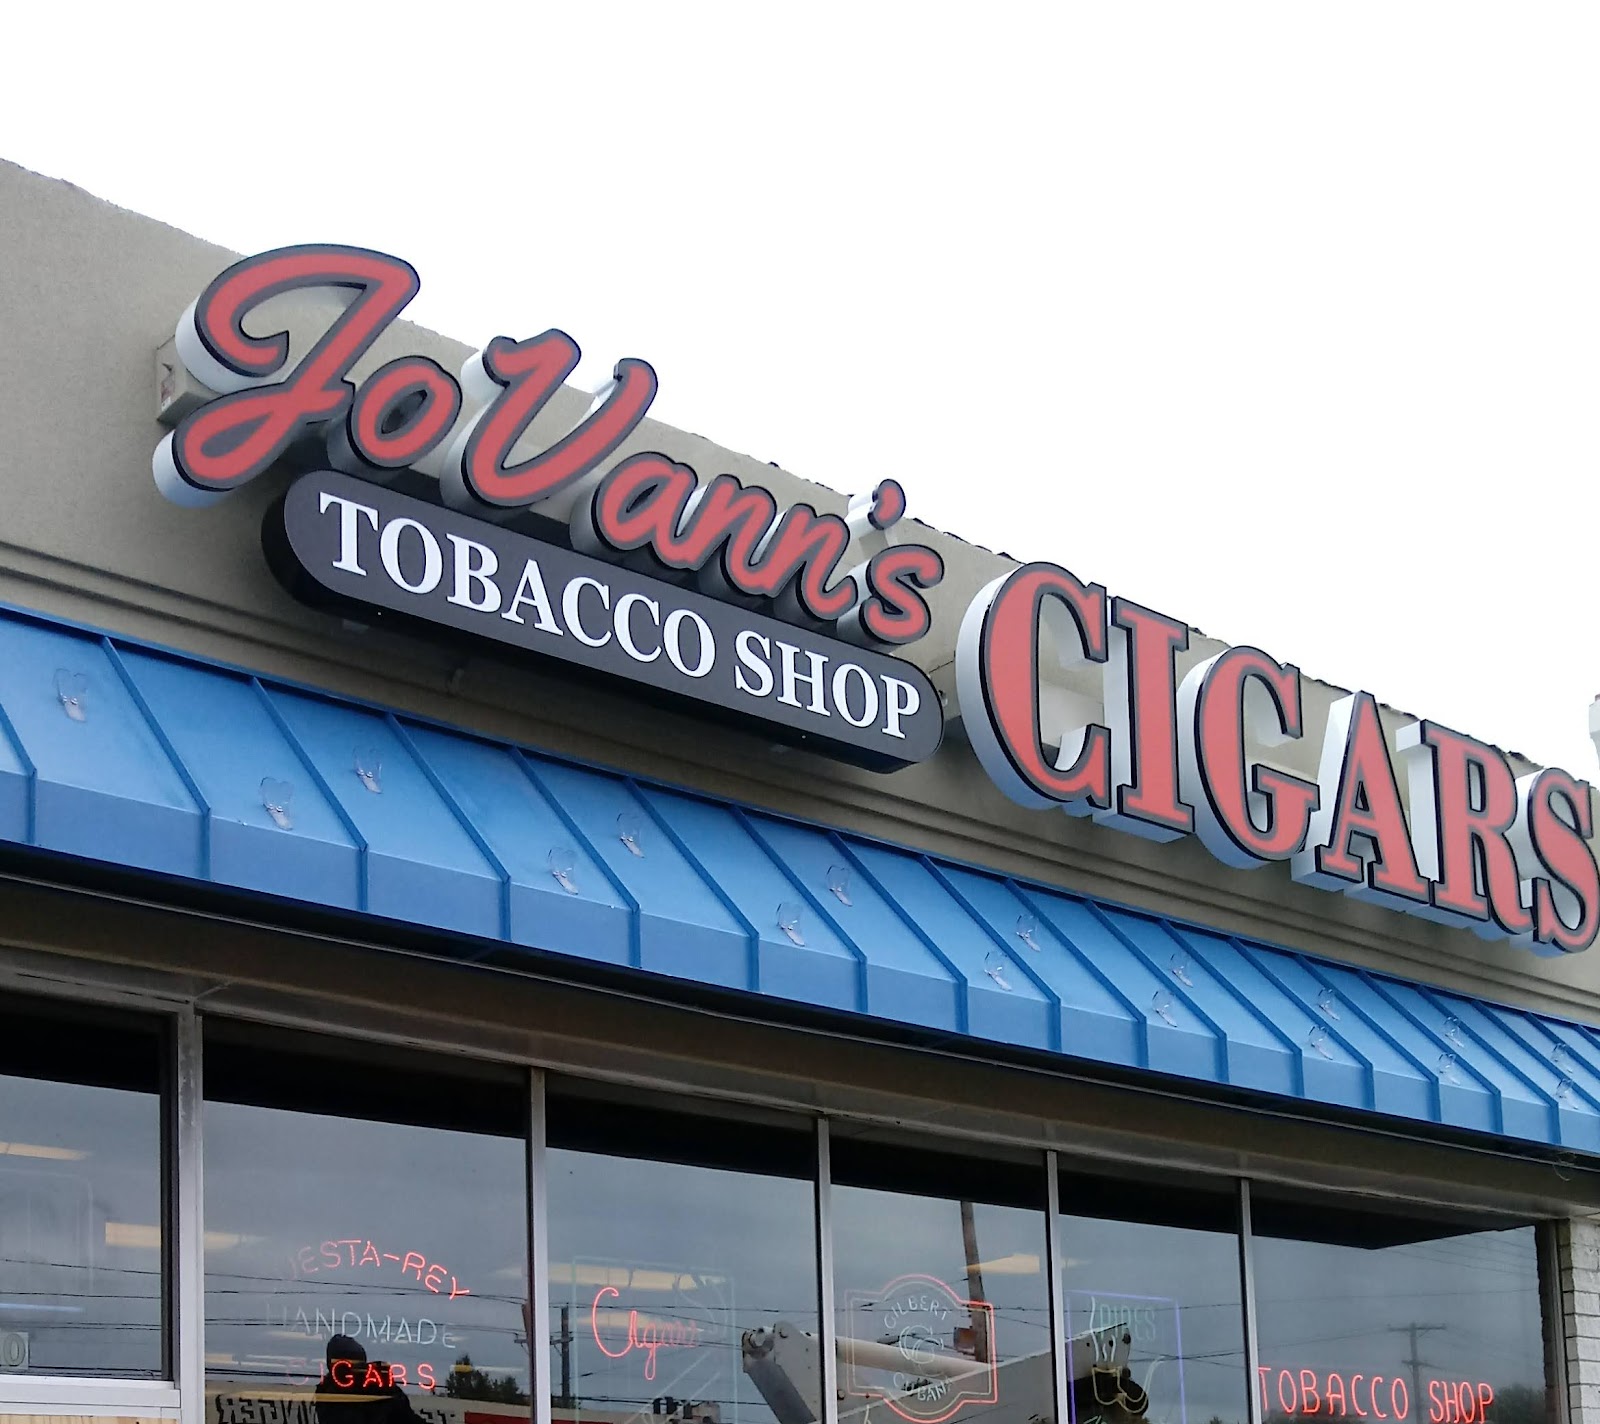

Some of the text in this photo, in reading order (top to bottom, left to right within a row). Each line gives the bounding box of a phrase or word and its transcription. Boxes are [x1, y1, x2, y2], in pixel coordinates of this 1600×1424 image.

[166, 243, 945, 646] JoVann's
[318, 491, 922, 741] TOBACCO SHOP
[970, 560, 1600, 955] CIGARS
[1258, 1366, 1496, 1424] TOBACCO SHOP
